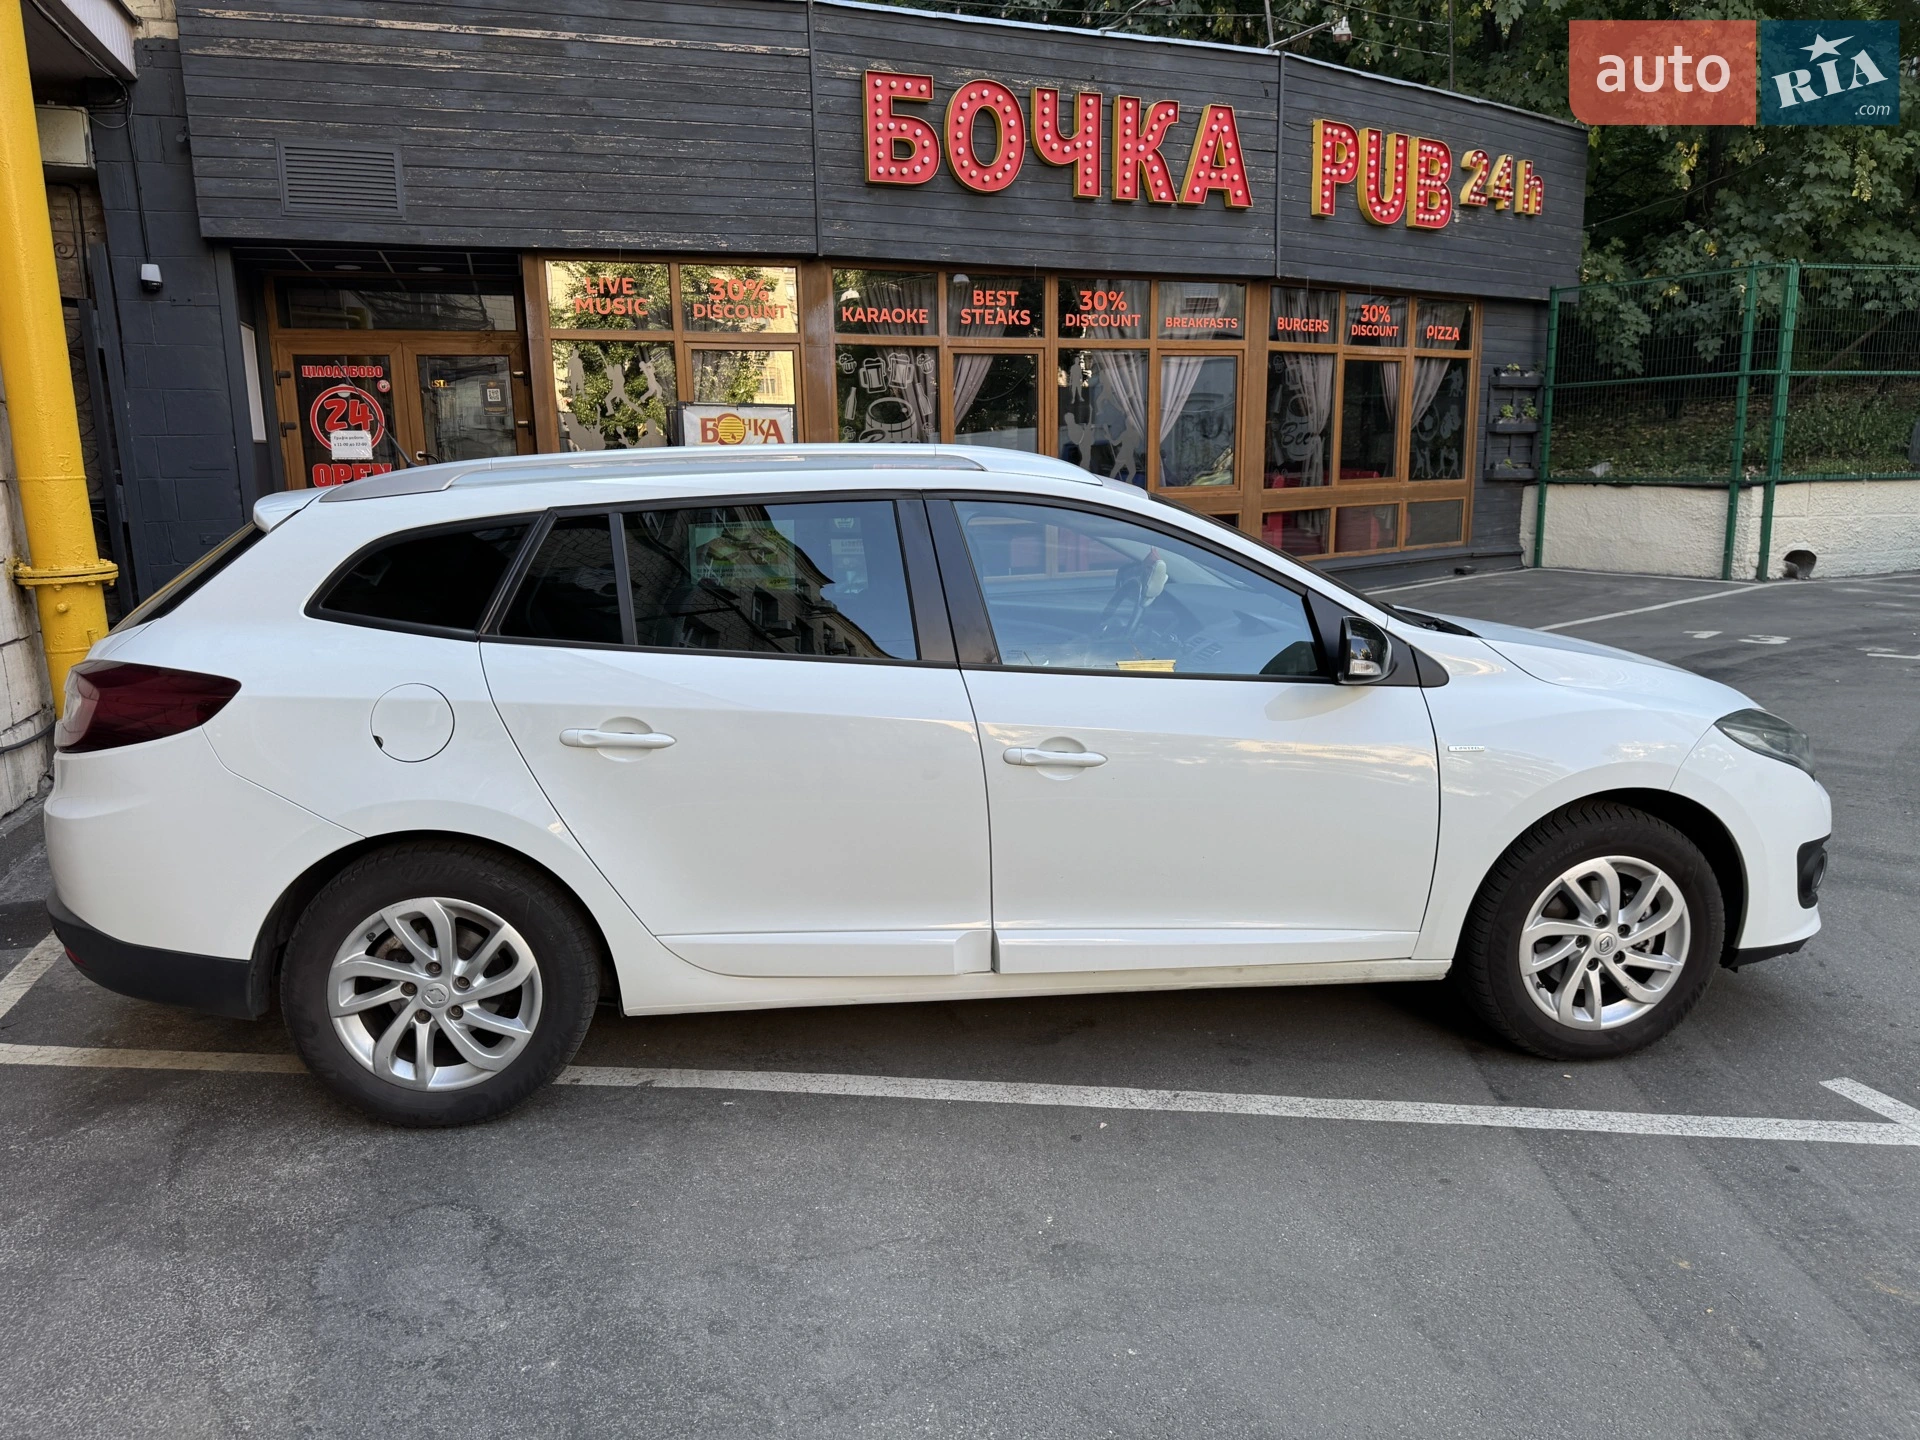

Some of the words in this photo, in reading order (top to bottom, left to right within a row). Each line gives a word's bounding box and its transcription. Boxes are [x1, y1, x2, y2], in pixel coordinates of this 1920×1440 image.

[863, 69, 1254, 209] БОЧКА
[1311, 118, 1452, 230] PUB
[1458, 149, 1544, 216] 24h
[585, 277, 635, 295] LIVE
[708, 277, 770, 302] 30%
[574, 298, 648, 316] MUSIC
[973, 290, 1019, 307] BEST
[1079, 290, 1128, 312] 30%
[693, 303, 788, 320] DISCOUNT
[841, 306, 929, 325] KARAOKE
[960, 308, 1031, 326] STEAKS
[1065, 313, 1142, 328] DISCOUNT
[1360, 304, 1392, 323] 30%
[1165, 316, 1238, 330] BREAKFASTS
[1277, 316, 1329, 334] BURGERS
[1351, 323, 1399, 338] DISCOUNT
[1426, 324, 1460, 342] PIZZA
[324, 398, 374, 431] 24
[700, 413, 784, 445] БОЧКА
